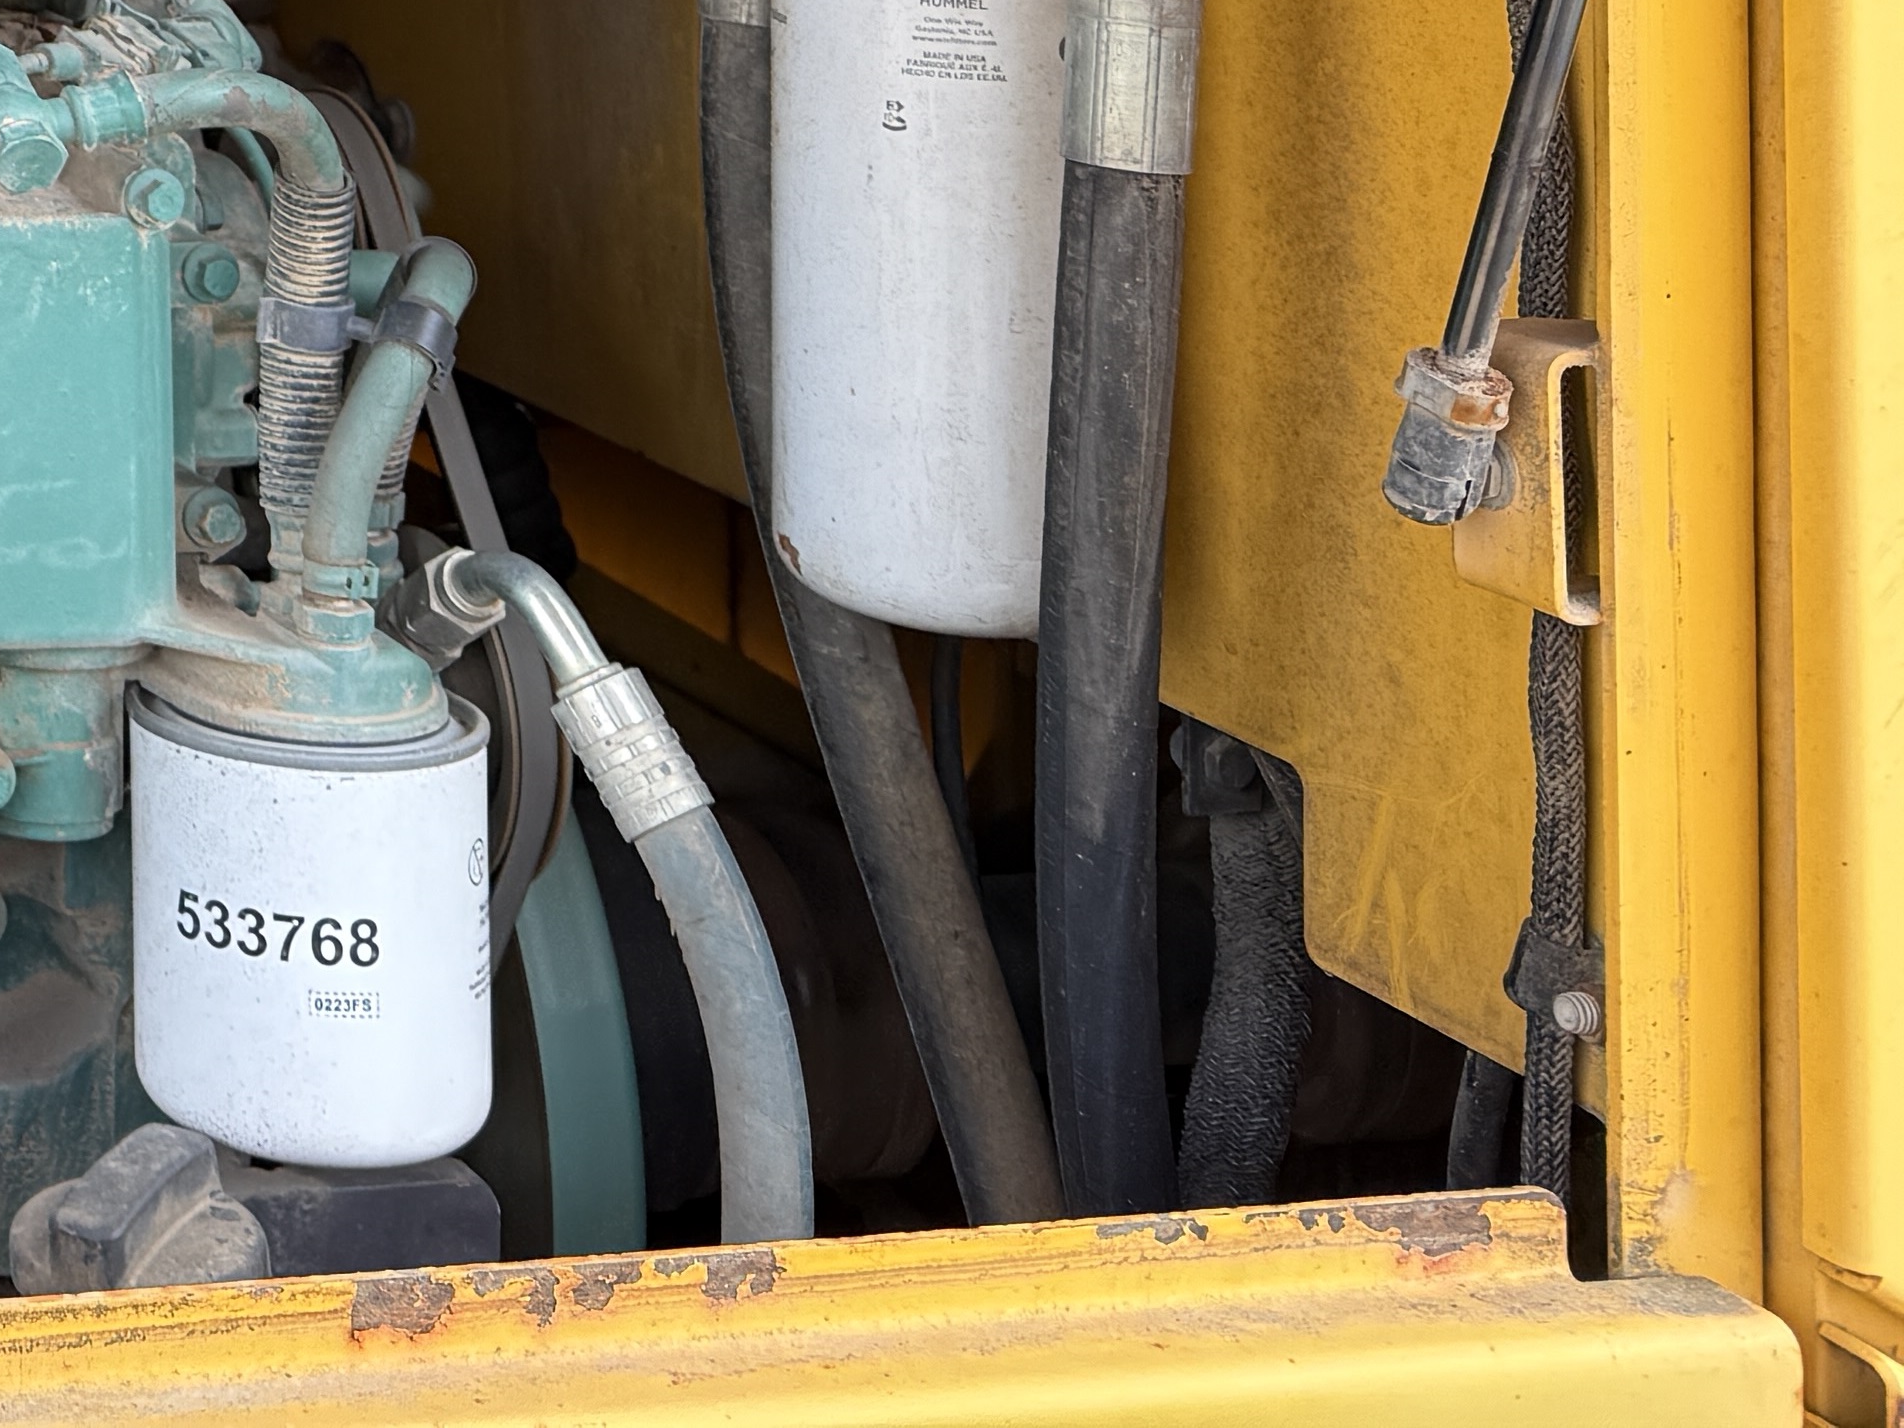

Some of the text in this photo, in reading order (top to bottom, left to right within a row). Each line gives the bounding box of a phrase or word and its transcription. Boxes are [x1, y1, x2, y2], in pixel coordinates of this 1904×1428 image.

[922, 50, 951, 61] MADE
[176, 888, 381, 967] 533768
[315, 996, 373, 1013] 0223FS
